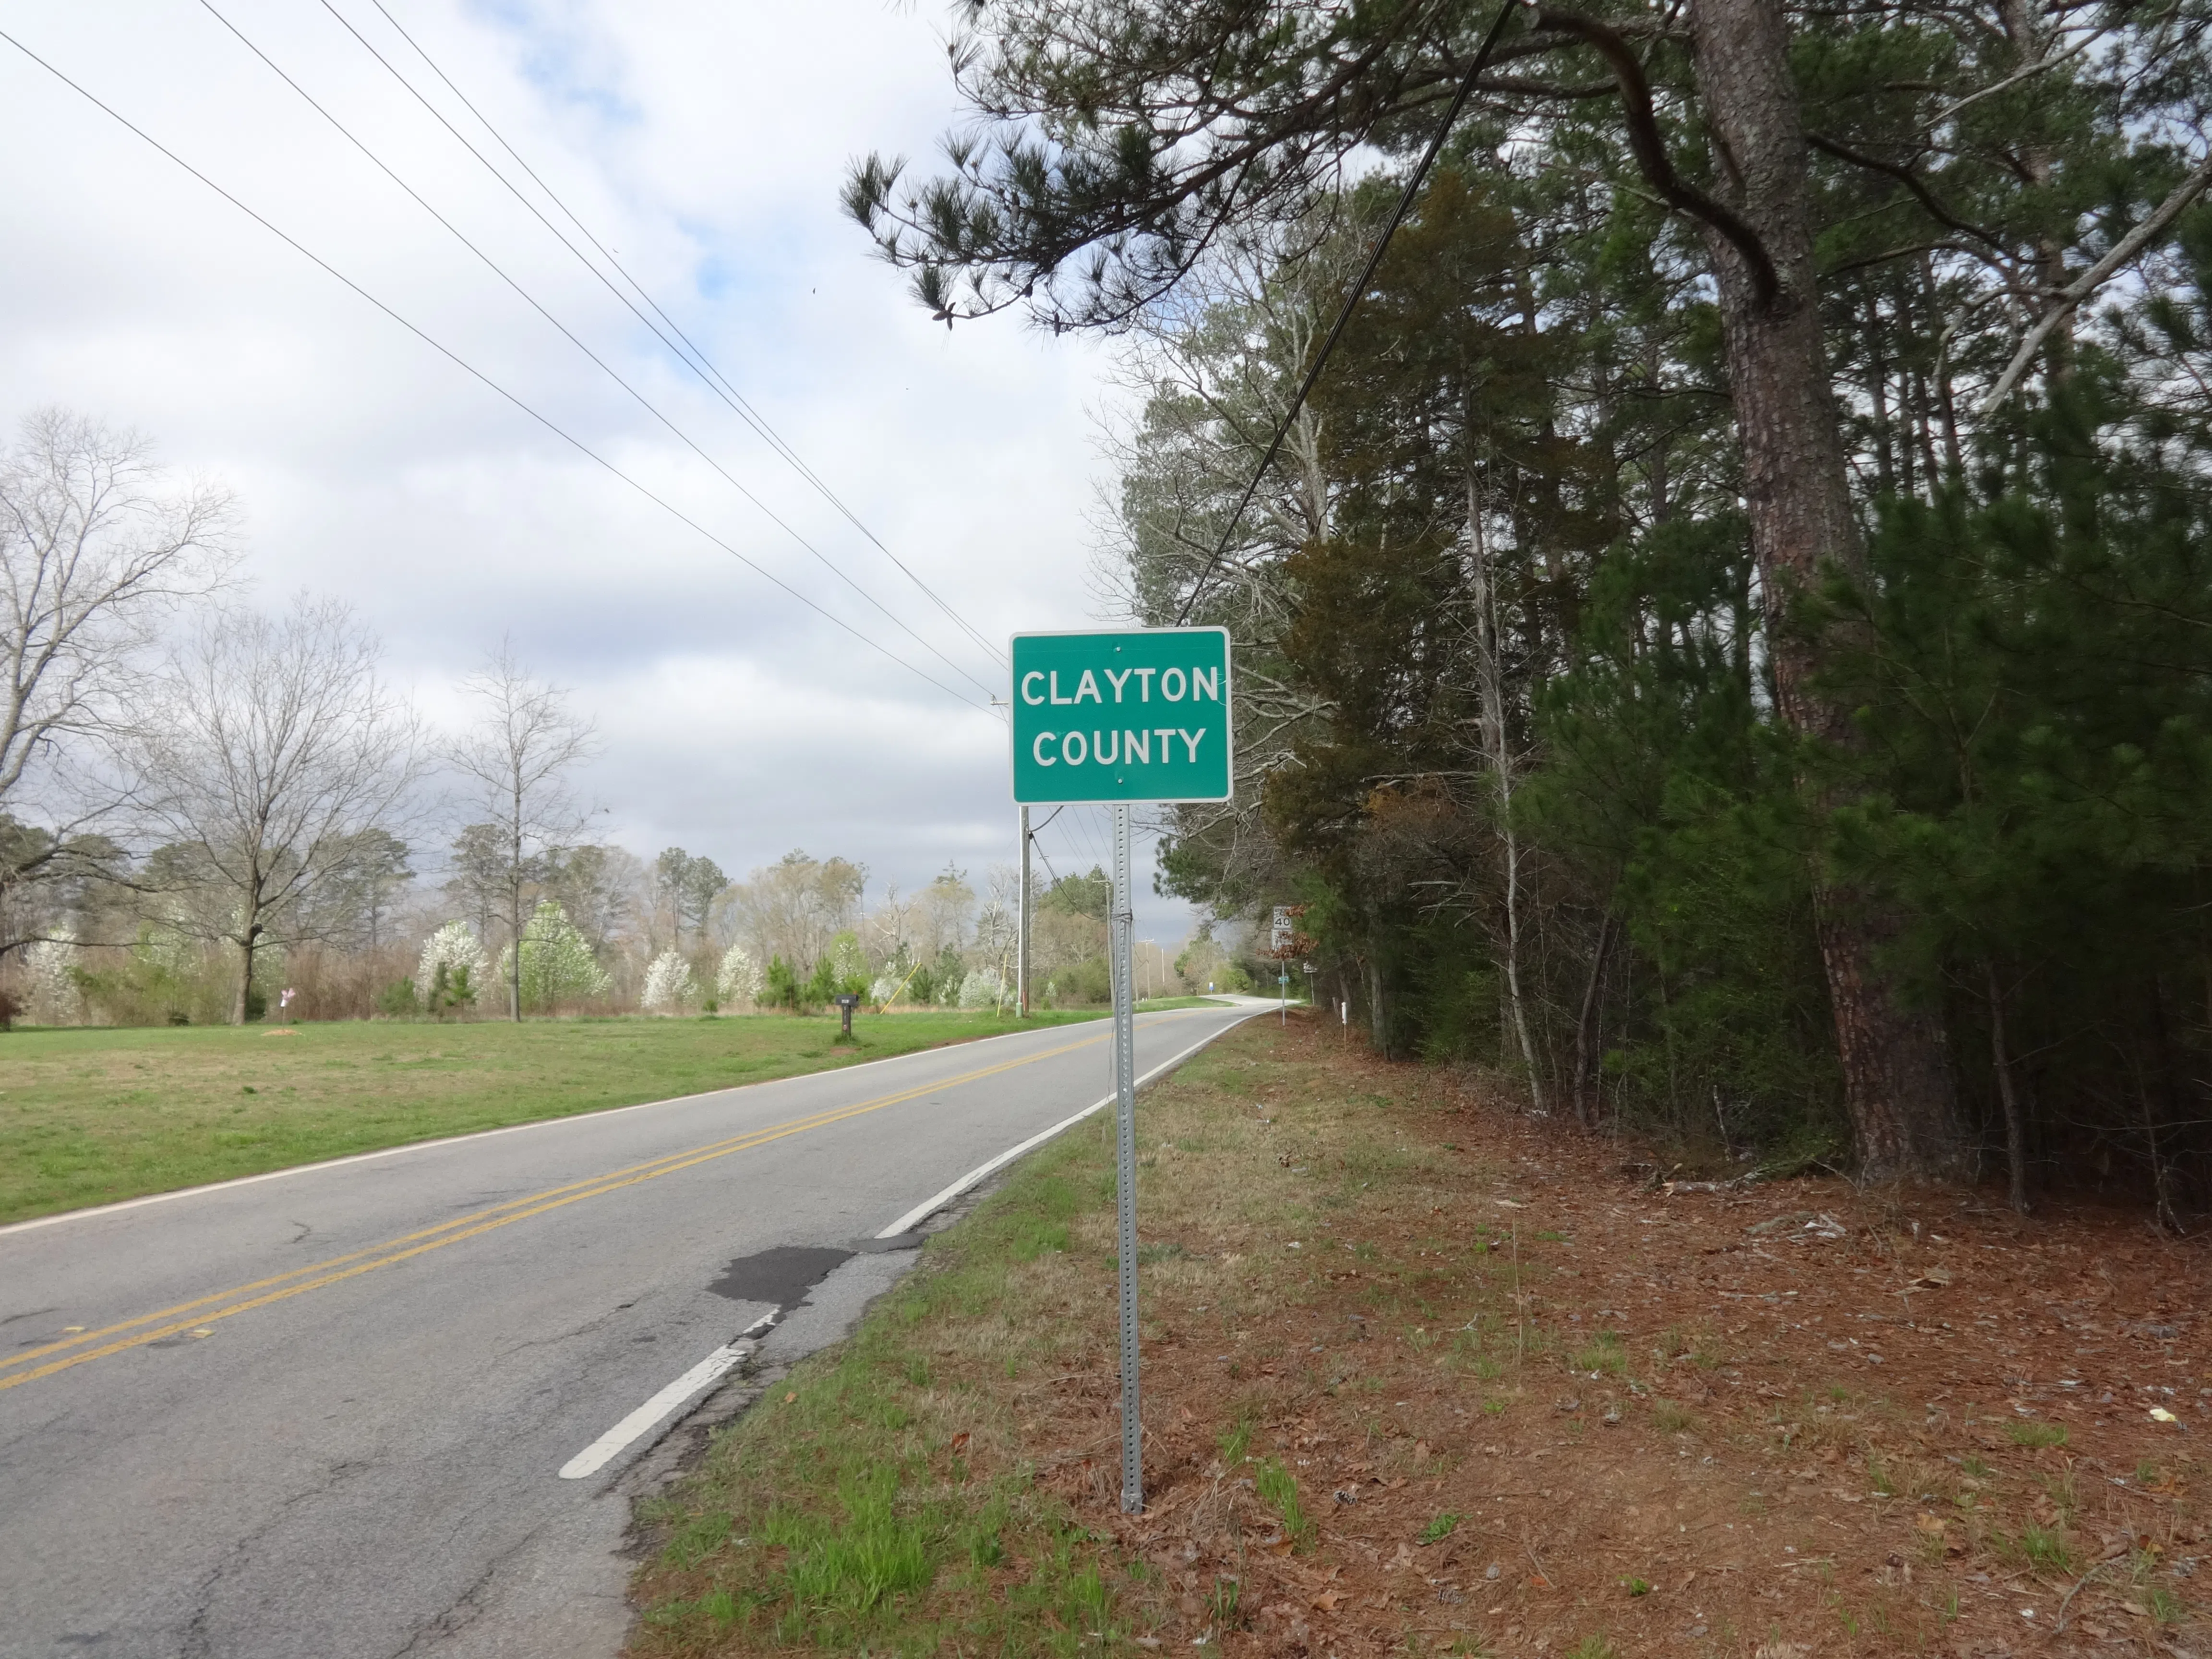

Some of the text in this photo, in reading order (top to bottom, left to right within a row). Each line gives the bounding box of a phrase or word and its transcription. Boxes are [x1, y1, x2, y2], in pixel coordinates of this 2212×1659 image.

[1021, 666, 1217, 706] CLAYTON
[1033, 728, 1206, 767] COUNTY
[1274, 918, 1290, 926] 40
